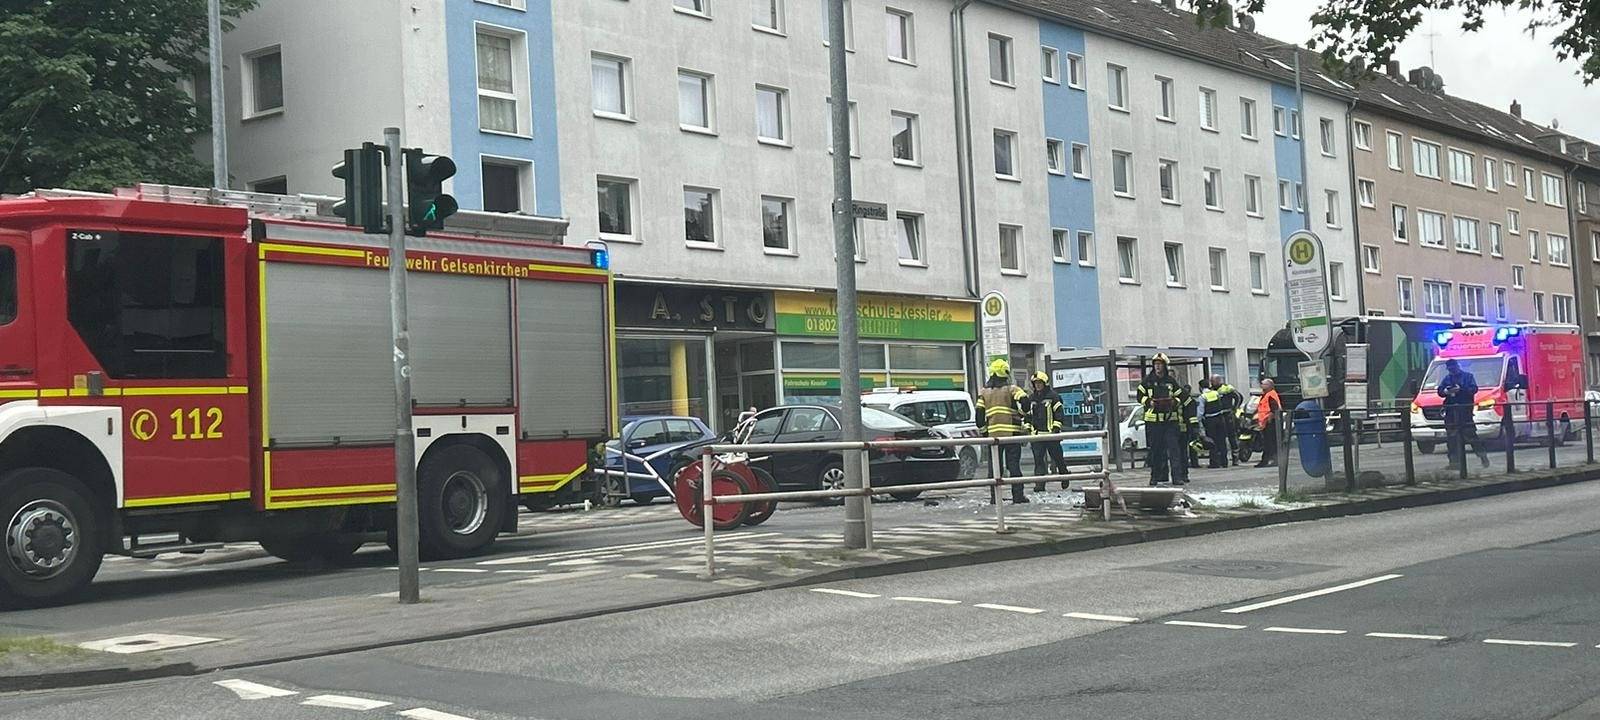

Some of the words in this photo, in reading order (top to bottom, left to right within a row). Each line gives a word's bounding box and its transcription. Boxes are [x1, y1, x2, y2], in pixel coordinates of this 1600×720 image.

[366, 251, 437, 271] Feuwehr
[441, 257, 529, 278] Gelsenkirchen
[1287, 259, 1293, 268] 2
[1081, 404, 1092, 413] iu
[170, 407, 223, 440] 112
